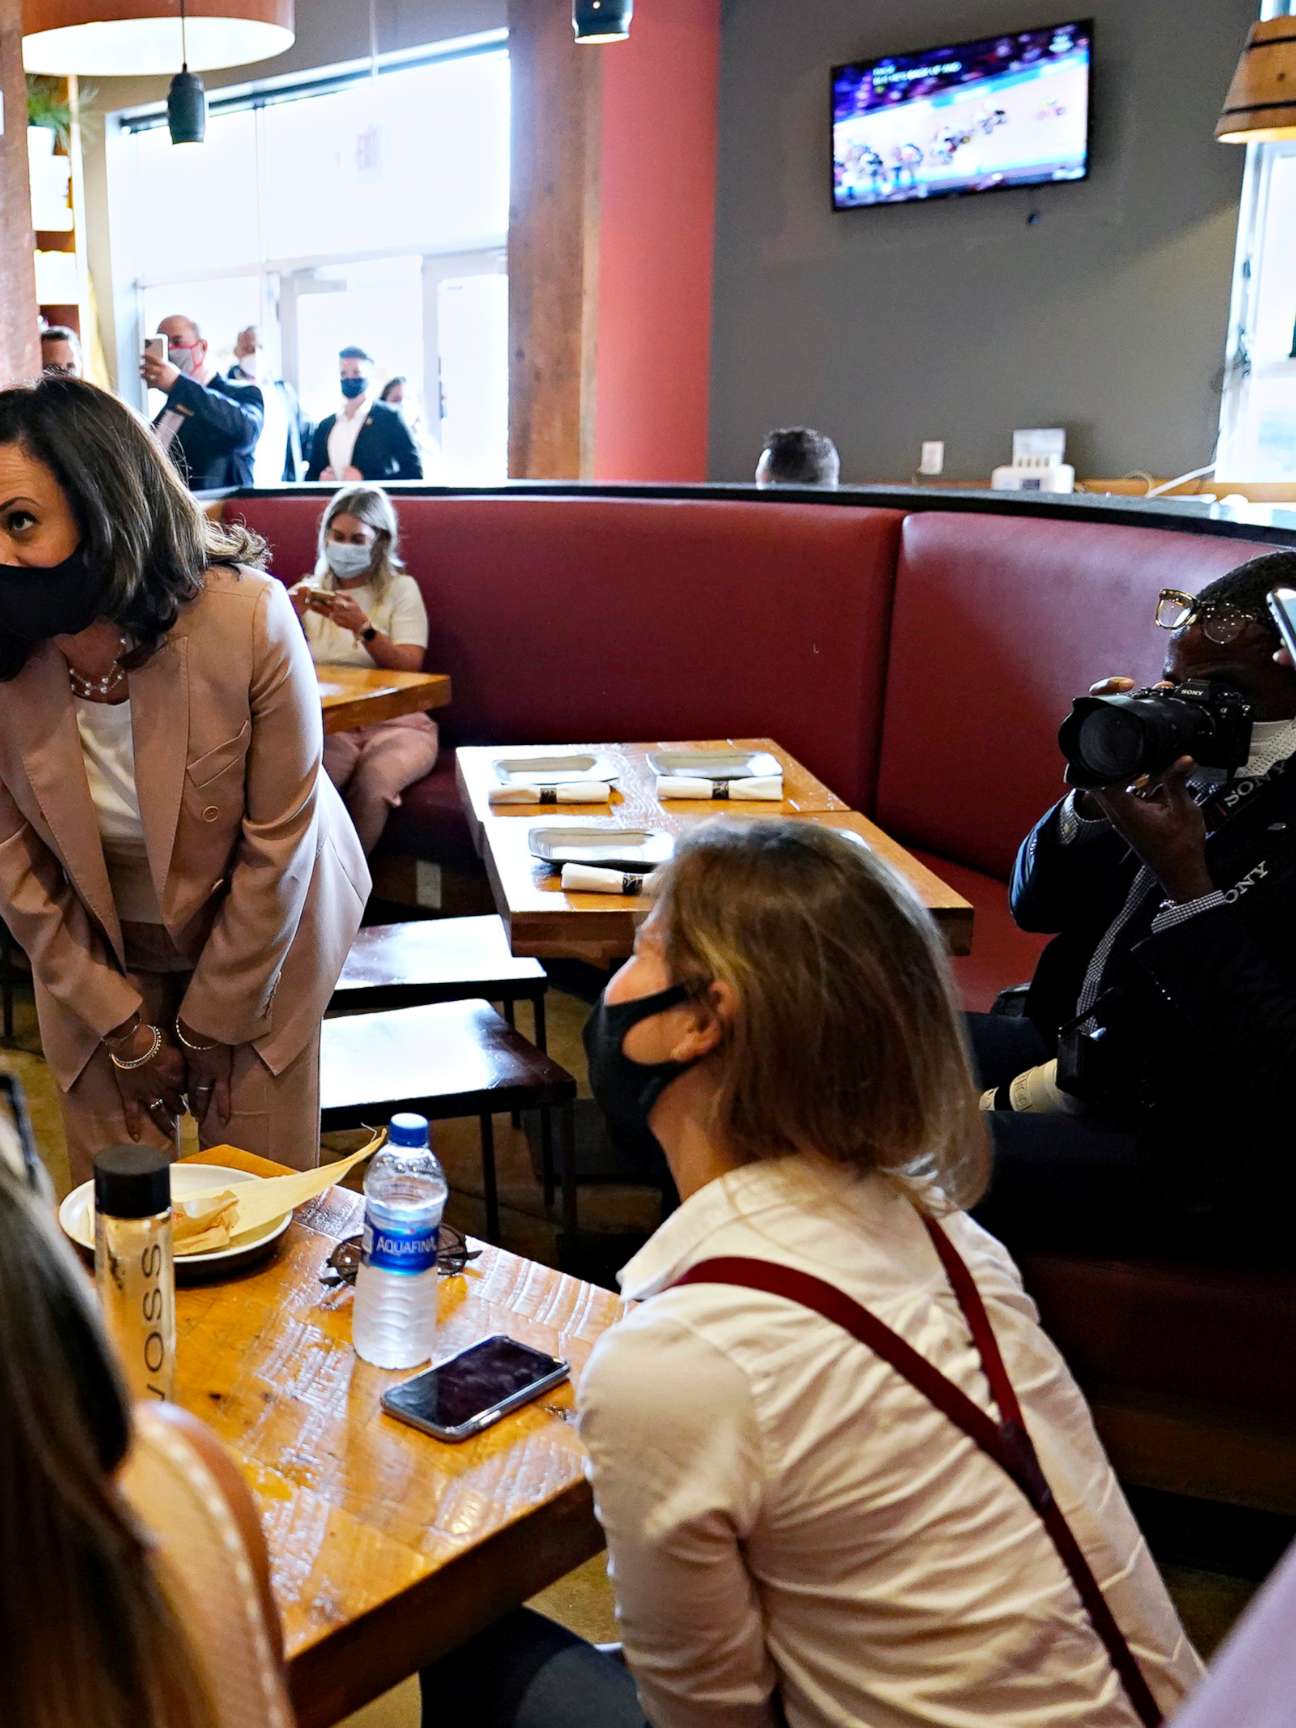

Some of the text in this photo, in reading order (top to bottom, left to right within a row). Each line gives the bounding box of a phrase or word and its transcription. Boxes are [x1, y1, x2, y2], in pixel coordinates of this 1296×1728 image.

[1181, 688, 1204, 697] SONY
[1224, 860, 1269, 904] ONY
[375, 1236, 437, 1257] AQUAFINA
